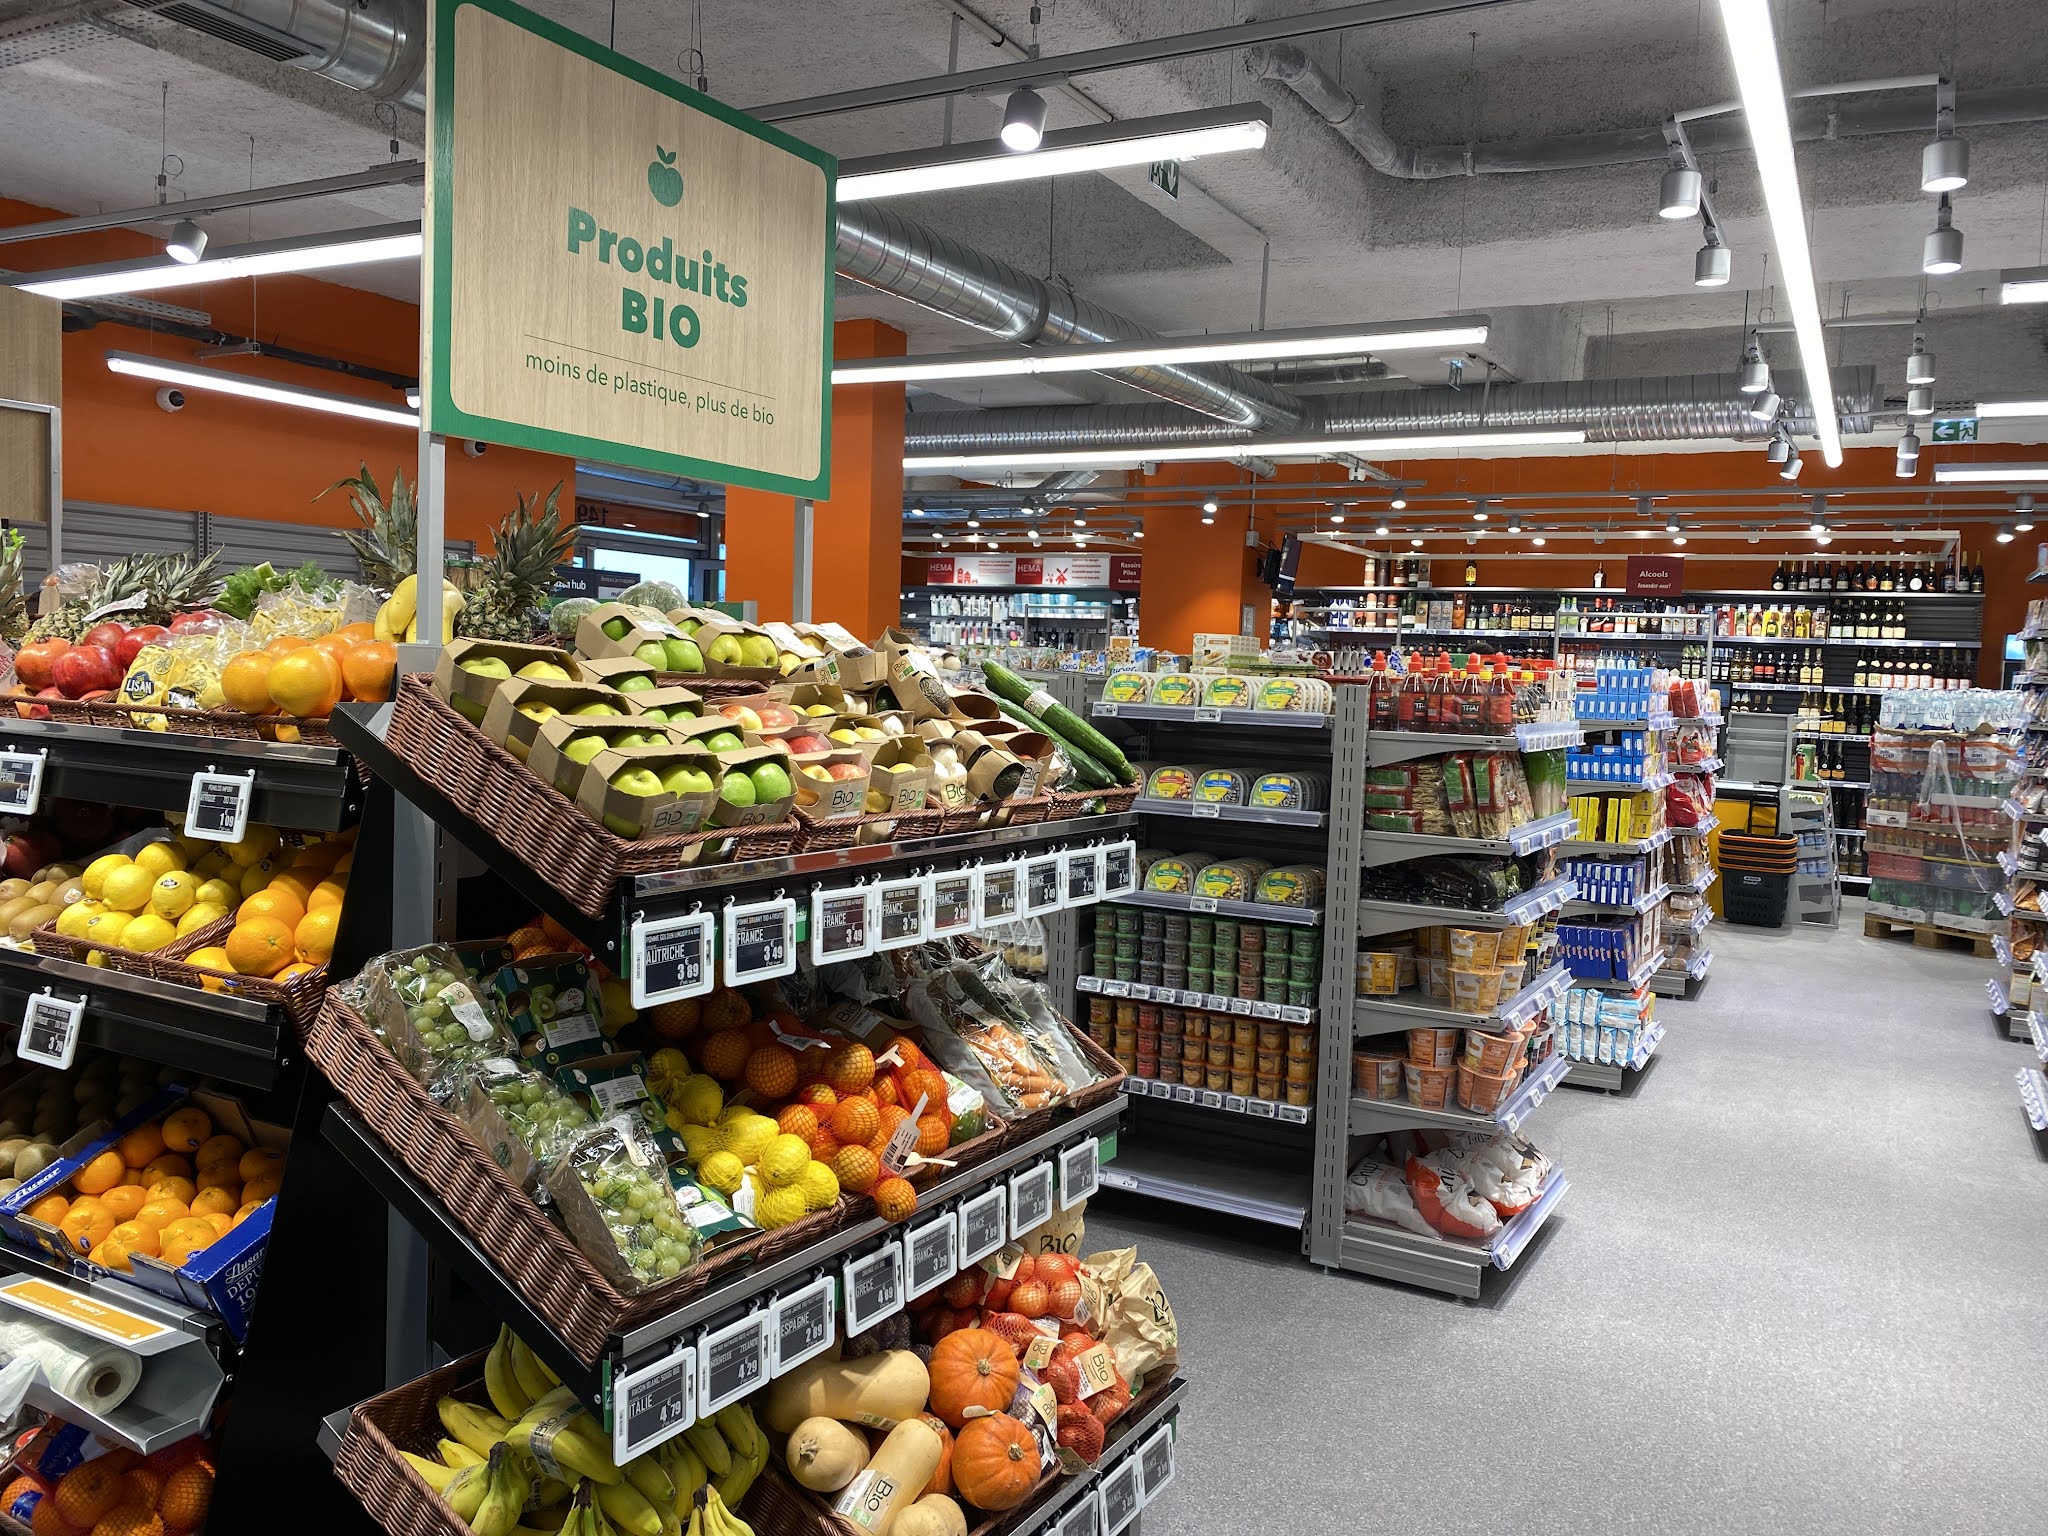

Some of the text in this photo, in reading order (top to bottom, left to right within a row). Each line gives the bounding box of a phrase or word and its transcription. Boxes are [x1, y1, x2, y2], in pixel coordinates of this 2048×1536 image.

[568, 206, 748, 308] Produits
[621, 287, 700, 349] BIO
[525, 351, 774, 425] moins de plastique, plus de bio
[930, 564, 952, 572] HEMA
[1017, 565, 1041, 573] HEMA
[571, 579, 587, 590] hub
[126, 678, 155, 694] LISAN
[882, 903, 903, 916] FRANCE
[824, 913, 847, 927] FRANCE
[737, 929, 764, 945] FRANCE
[646, 944, 685, 965] AUTRICHE
[914, 1244, 934, 1265] FRANCE
[855, 1278, 874, 1298] GRECE
[780, 1311, 810, 1337] ESPAGNE
[646, 1376, 660, 1389] BLANC
[629, 1394, 653, 1418] ITALIE
